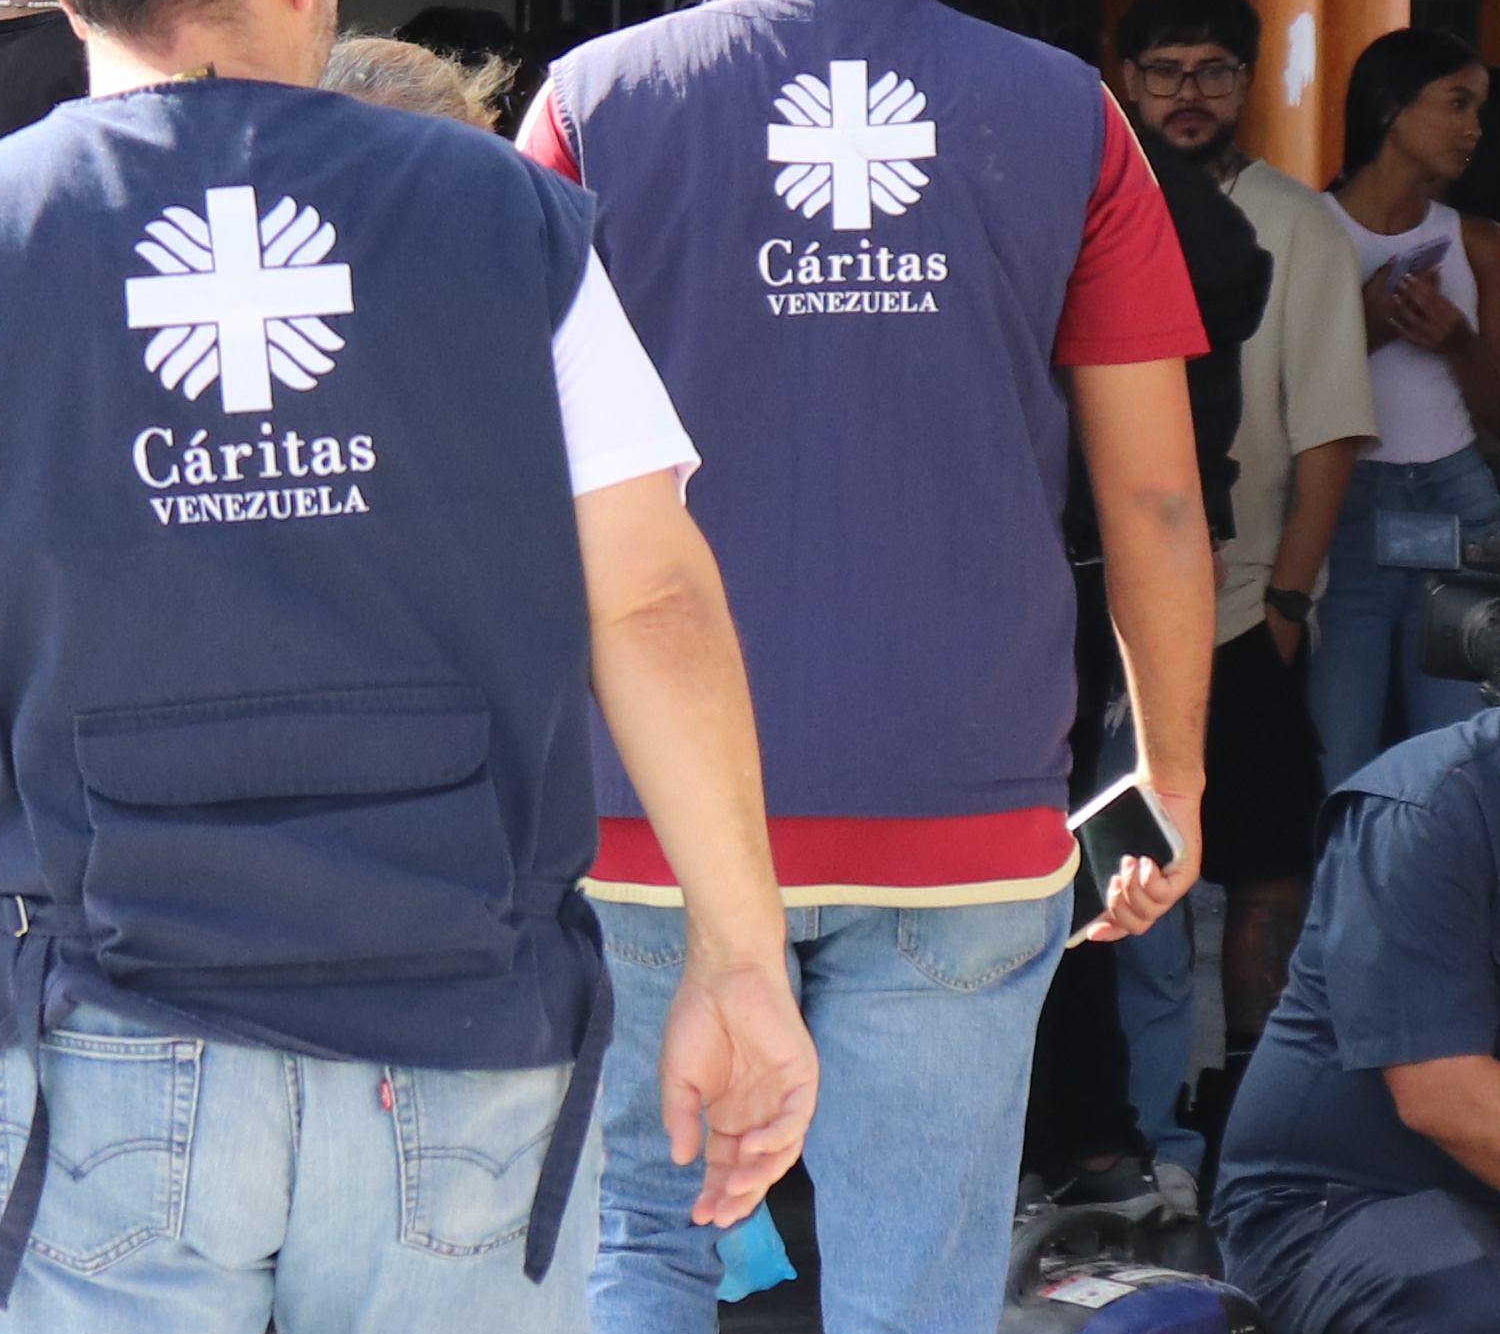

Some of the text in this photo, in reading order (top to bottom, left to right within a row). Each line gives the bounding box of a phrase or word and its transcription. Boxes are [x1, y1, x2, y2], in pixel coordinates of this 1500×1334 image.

[757, 238, 950, 287] Cáritas
[766, 291, 940, 316] VENEZUELA
[132, 421, 378, 489] Cáritas
[150, 485, 369, 526] VENEZUELA
